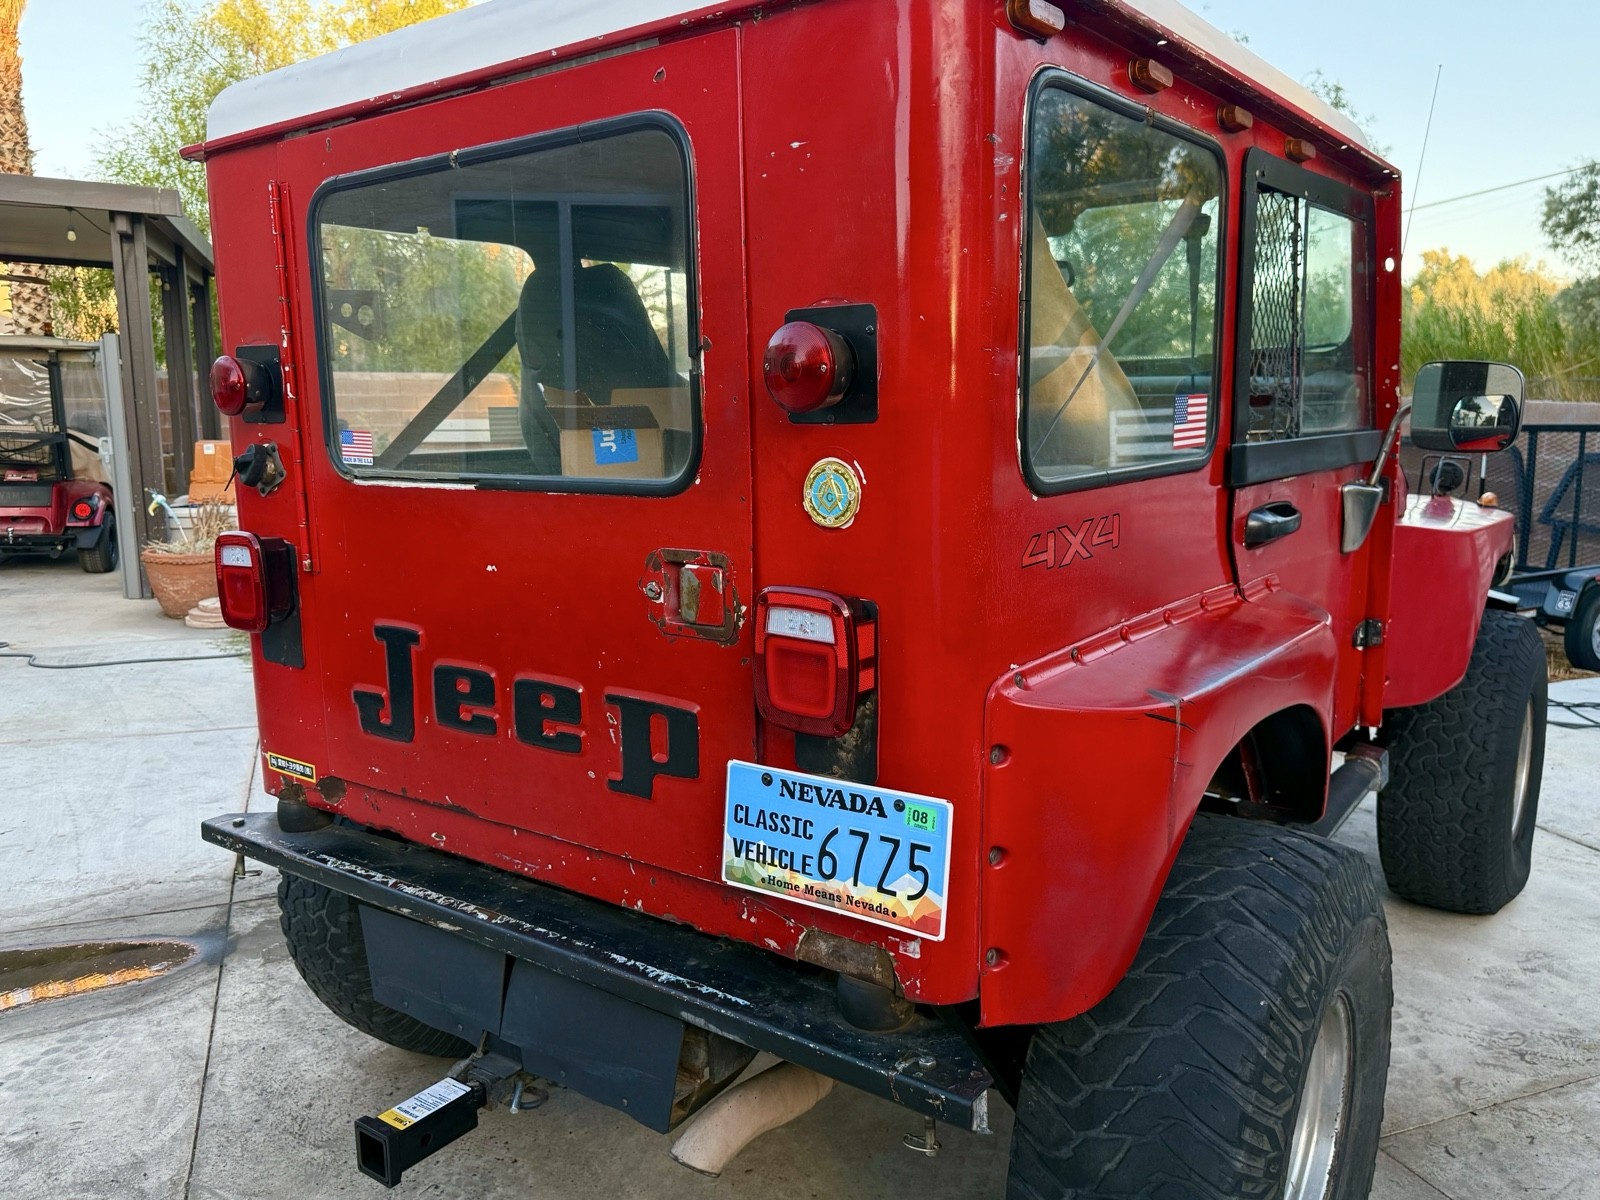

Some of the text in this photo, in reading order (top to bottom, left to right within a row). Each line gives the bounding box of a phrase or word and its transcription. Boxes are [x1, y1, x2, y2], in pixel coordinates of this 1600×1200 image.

[1558, 601, 1570, 609] 65
[353, 619, 701, 800] Jeep
[780, 779, 887, 819] NEVADA
[912, 809, 928, 825] 08
[734, 804, 813, 840] CLASSIC
[733, 837, 813, 876] VEHICLE
[767, 875, 891, 917] Home Means Nevada
